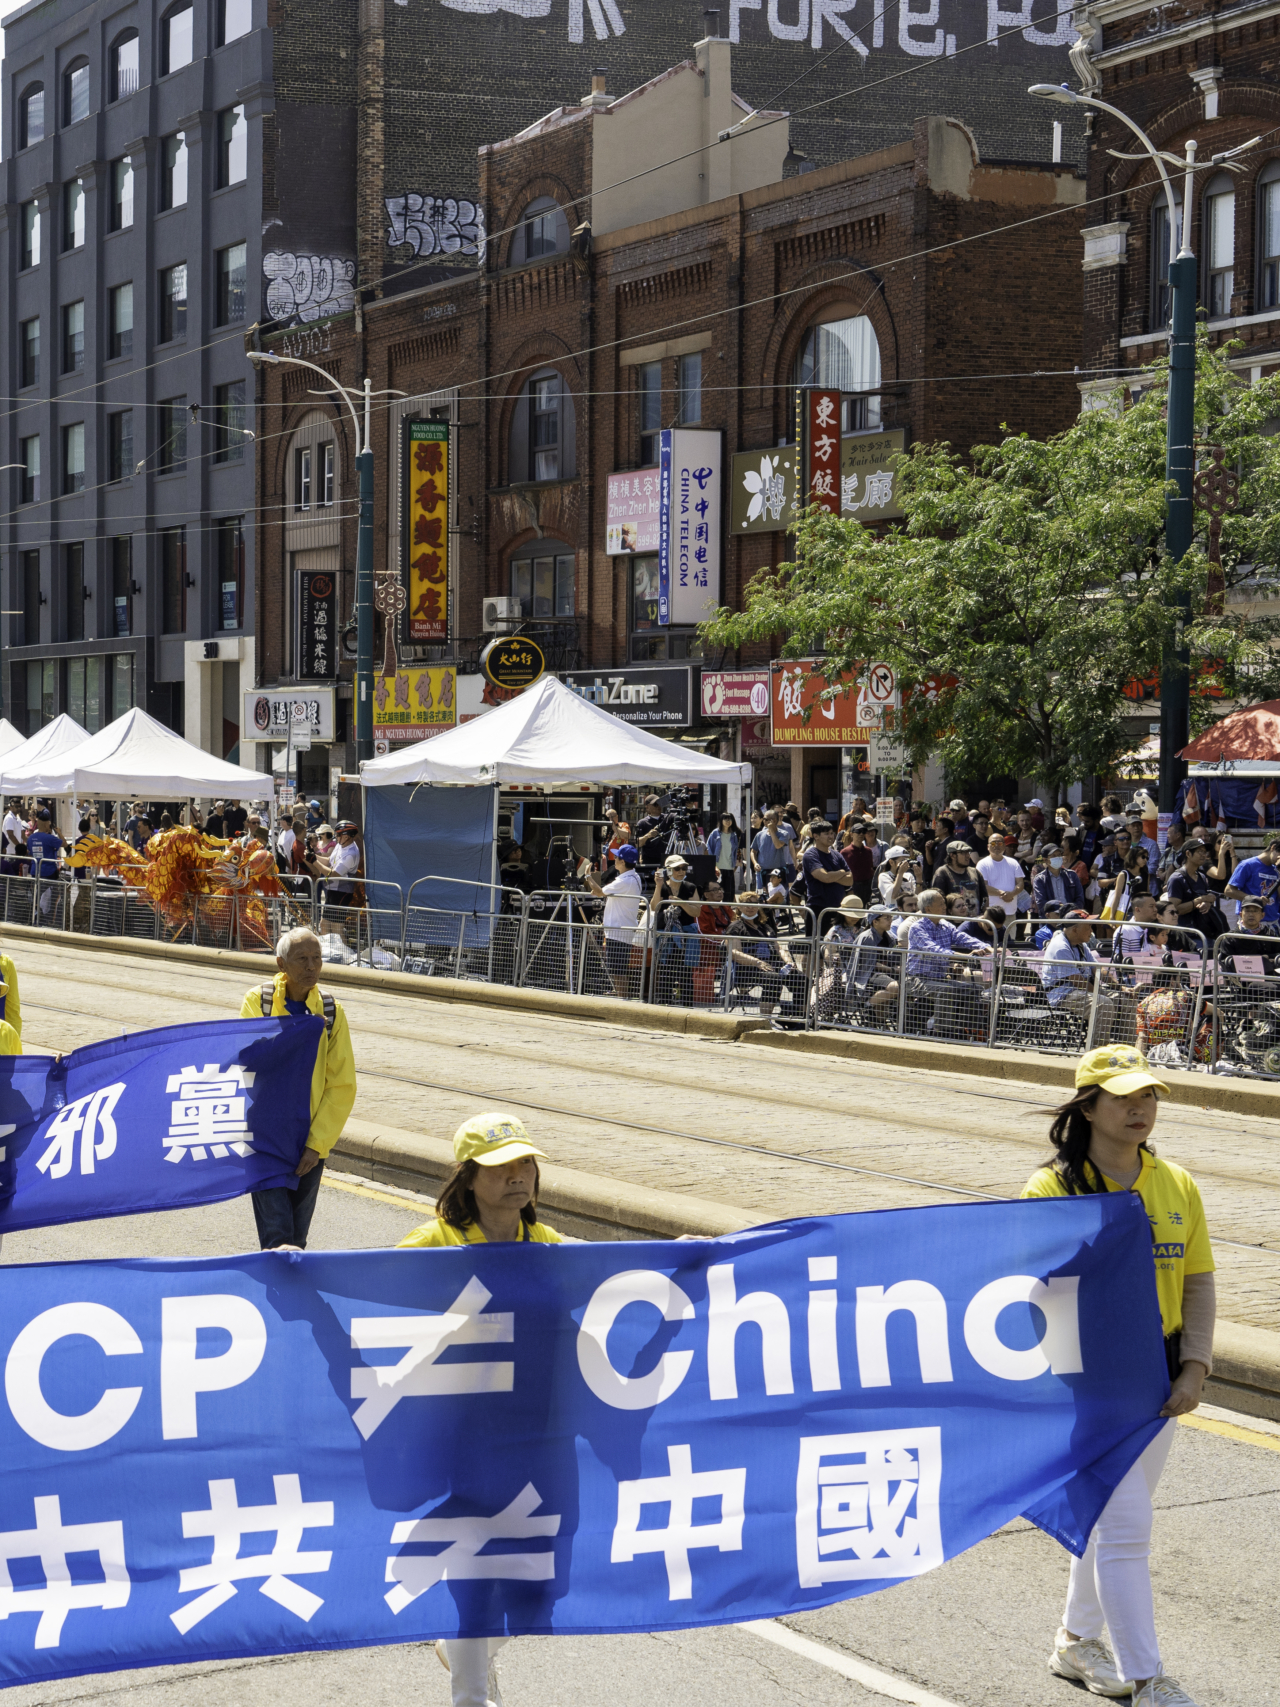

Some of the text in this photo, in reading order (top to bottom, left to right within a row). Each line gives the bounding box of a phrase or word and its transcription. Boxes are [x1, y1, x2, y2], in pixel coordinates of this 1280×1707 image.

[608, 503, 628, 518] Zhen
[628, 501, 647, 516] Zhen
[680, 468, 690, 587] CHINA TELECOM
[693, 497, 710, 588] 中国电信
[742, 674, 754, 682] Health
[755, 673, 768, 682] Center
[725, 688, 750, 698] Foot Massage
[648, 712, 662, 720] Your
[663, 711, 682, 720] Phone
[385, 728, 406, 739] NGUYEN
[406, 727, 424, 738] HUONG
[774, 728, 813, 742] DUMPLING
[814, 728, 841, 742] HOUSE
[577, 1256, 1084, 1410] China
